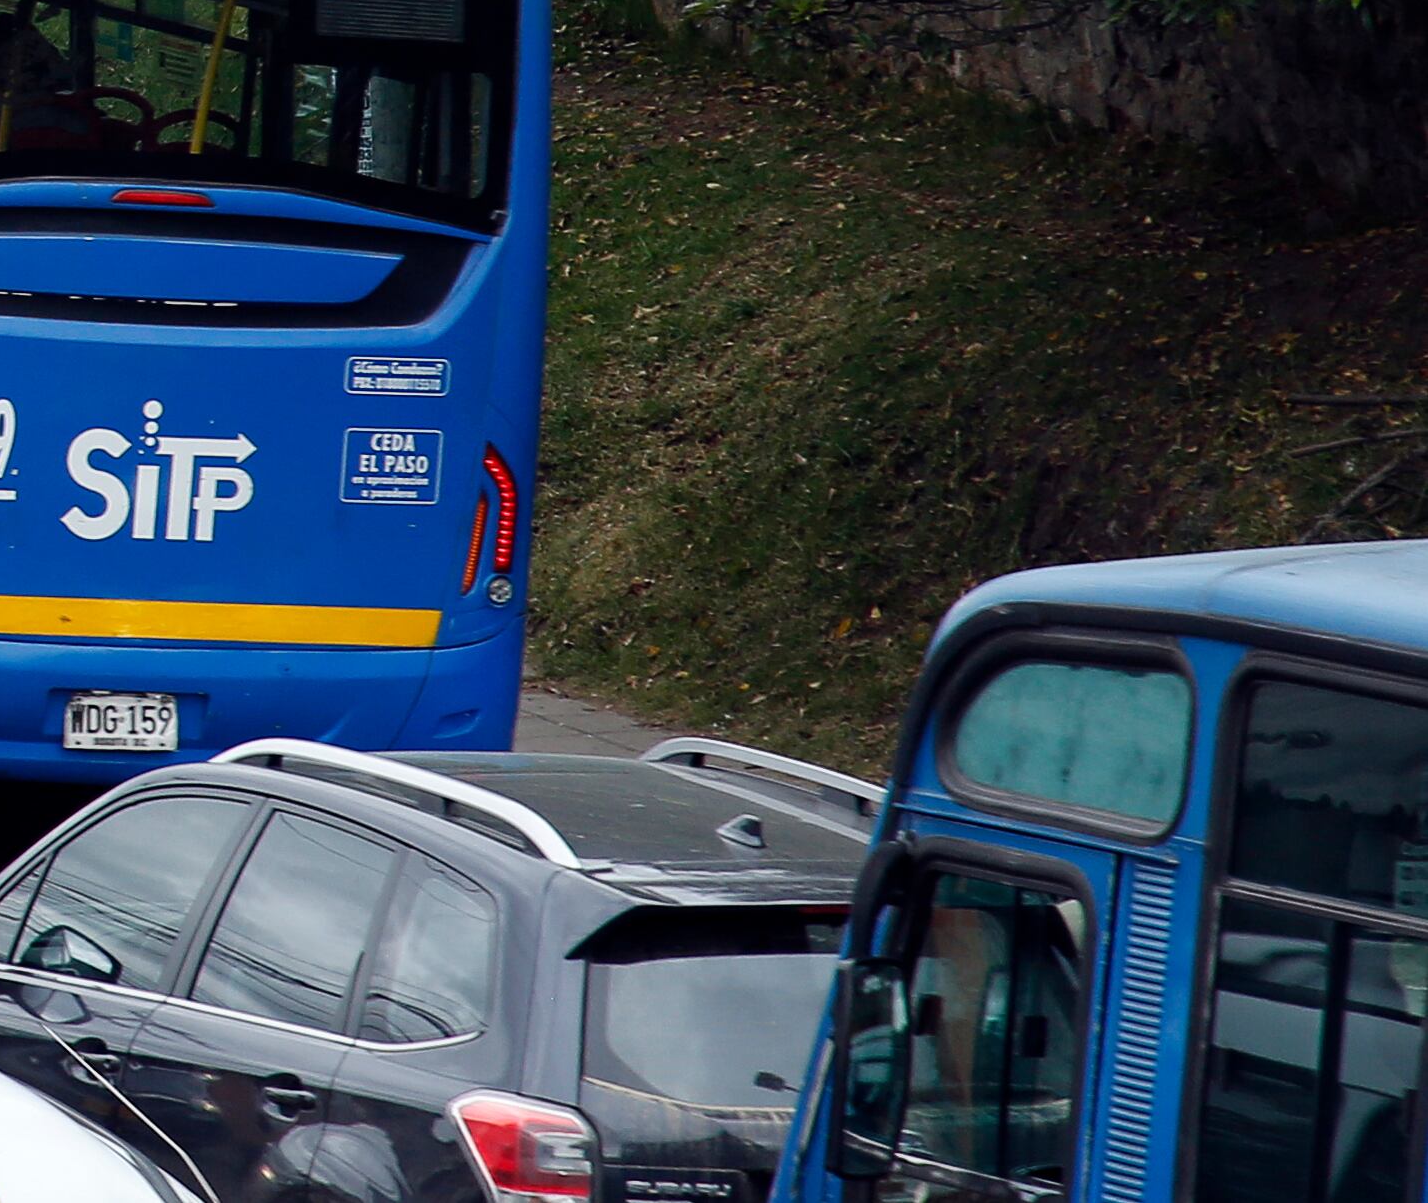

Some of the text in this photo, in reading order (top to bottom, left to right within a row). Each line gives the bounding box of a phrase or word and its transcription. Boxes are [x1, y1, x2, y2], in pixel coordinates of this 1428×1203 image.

[370, 433, 416, 452] CEDA
[358, 454, 429, 473] EL PASO
